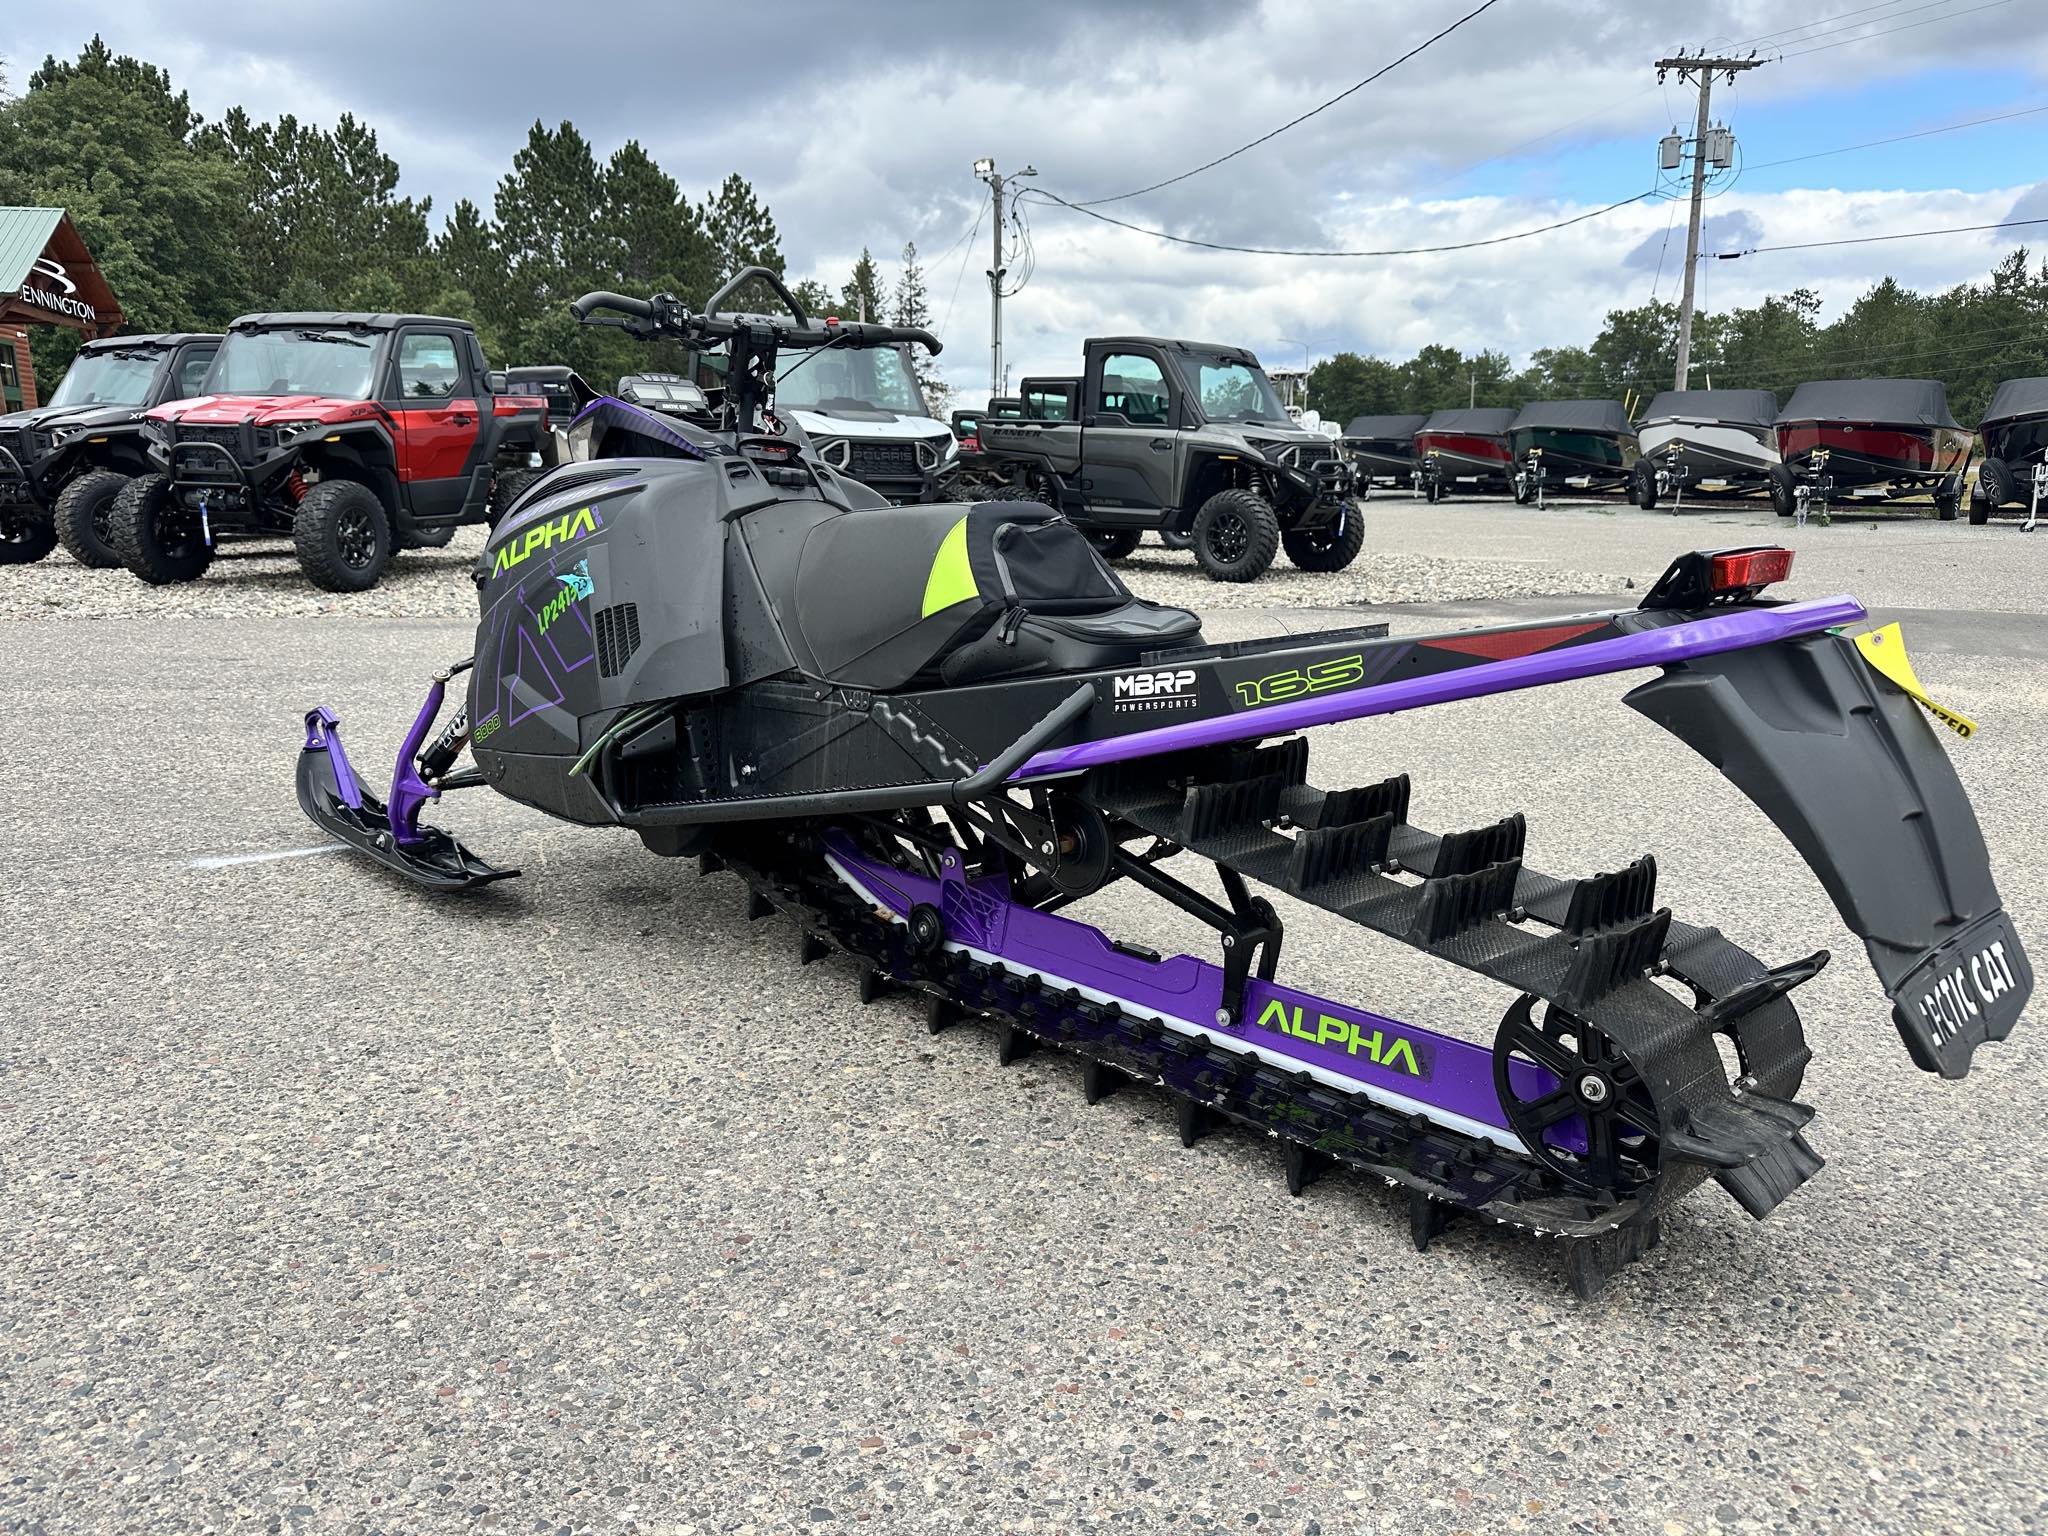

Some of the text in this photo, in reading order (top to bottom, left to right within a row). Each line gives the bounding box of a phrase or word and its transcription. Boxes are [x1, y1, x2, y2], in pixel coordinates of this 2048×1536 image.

[20, 284, 96, 321] ENNINGTON
[853, 450, 913, 461] POLARIS
[492, 508, 596, 579] ALPHA
[573, 578, 588, 592] 23
[1114, 669, 1197, 698] MBRP
[1236, 655, 1365, 707] 165
[1114, 699, 1197, 712] POWERSPORTS
[1971, 941, 2016, 1004] CAT
[1257, 1000, 1420, 1075] ALPHA
